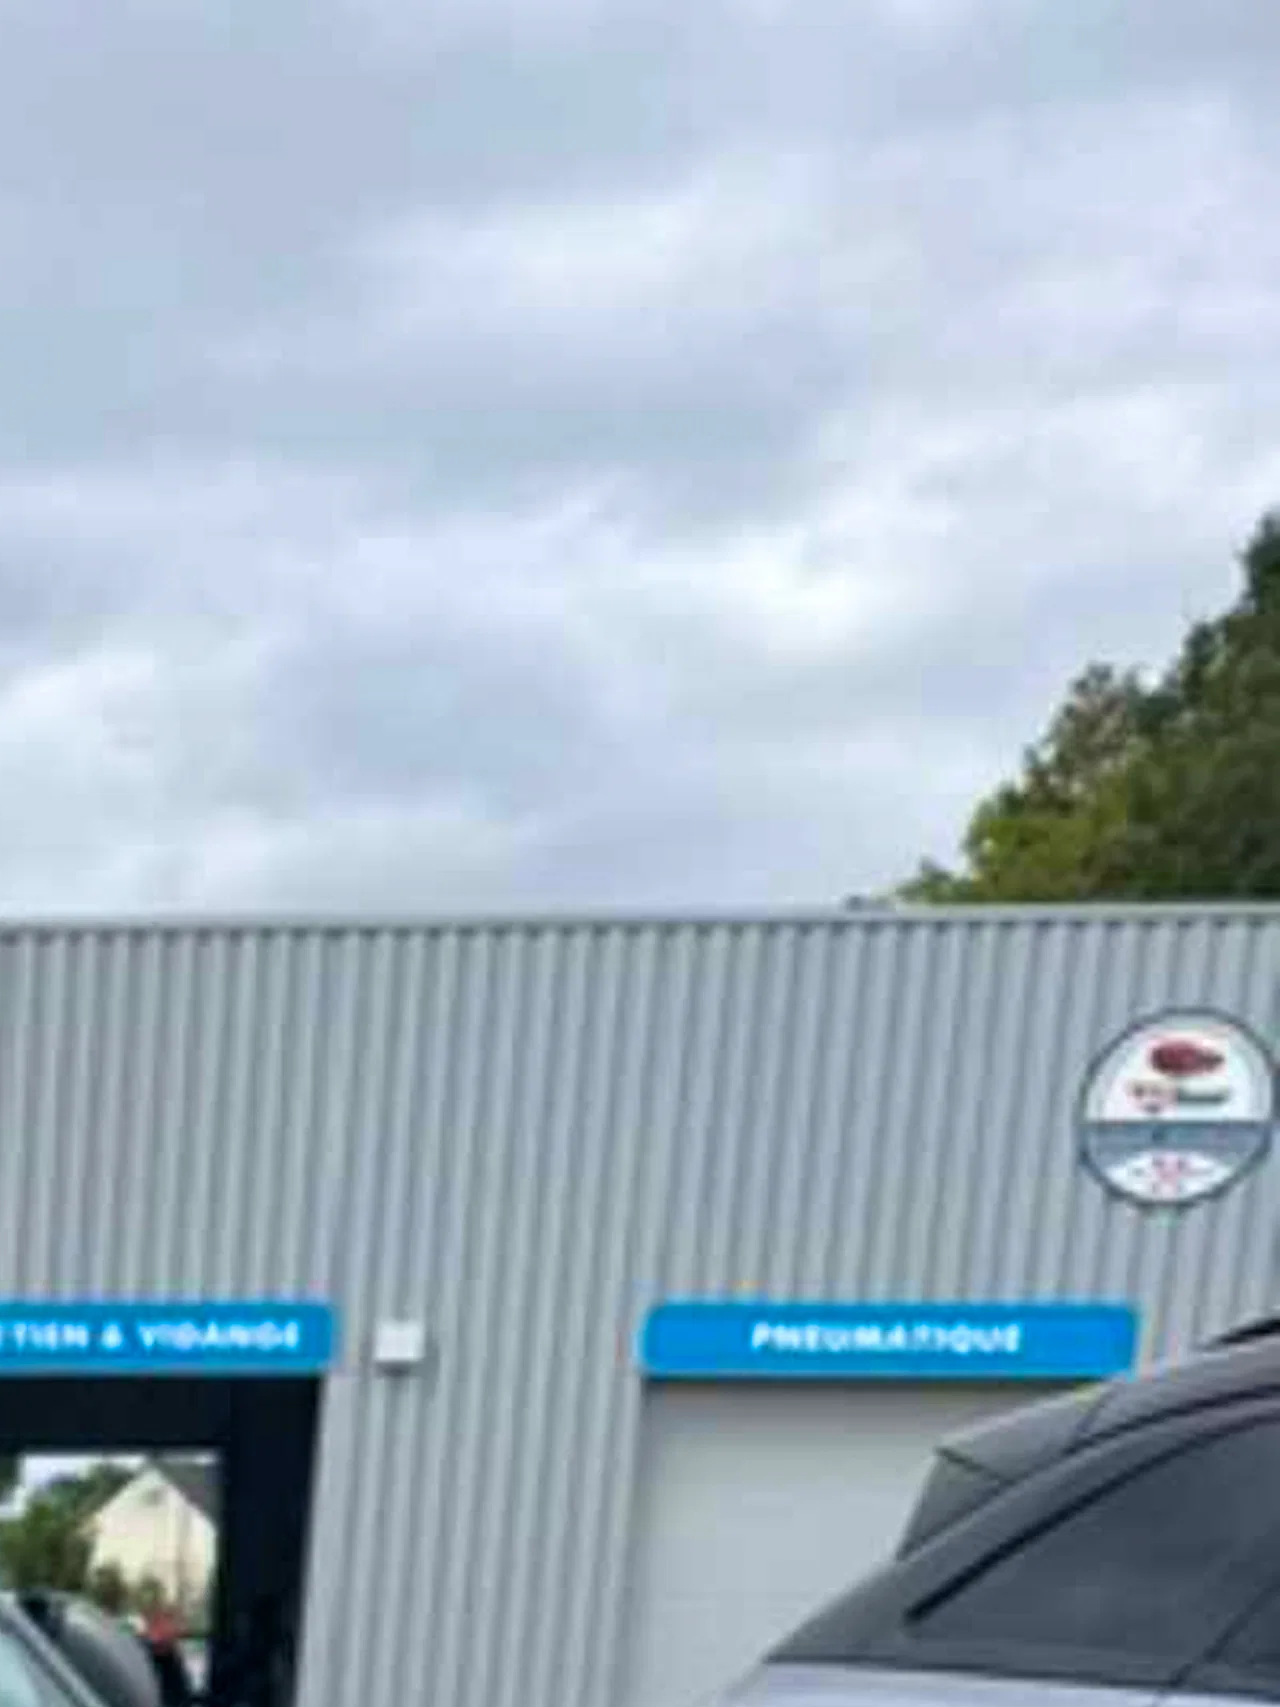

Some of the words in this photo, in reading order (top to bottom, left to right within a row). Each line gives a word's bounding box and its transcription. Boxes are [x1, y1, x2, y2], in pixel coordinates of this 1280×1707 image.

[98, 1321, 124, 1351] &
[136, 1319, 301, 1352] VIDANGE
[749, 1320, 1024, 1354] PNEUMATIQUE
